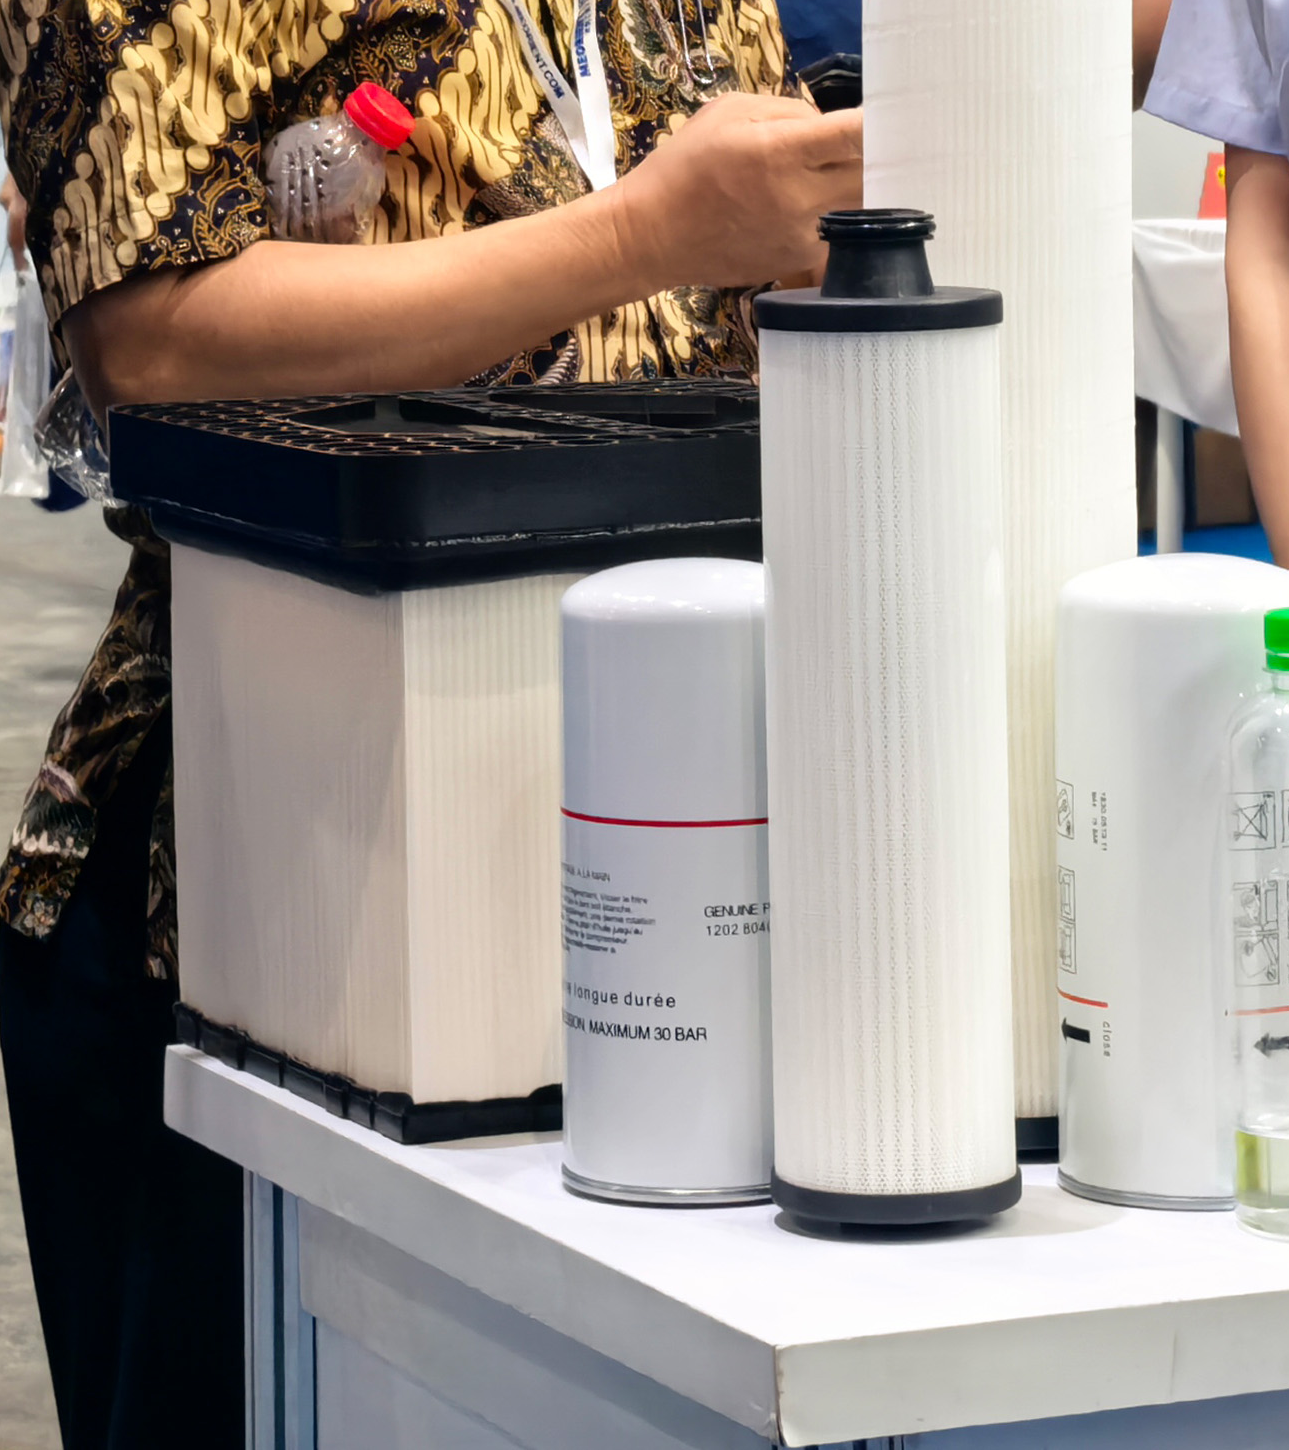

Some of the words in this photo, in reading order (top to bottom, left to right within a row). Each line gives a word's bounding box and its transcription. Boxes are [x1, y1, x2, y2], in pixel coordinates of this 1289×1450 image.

[704, 903, 759, 918] GENUINE
[706, 923, 739, 937] 1202
[573, 981, 619, 1006] longue
[623, 990, 677, 1009] durée
[589, 1018, 651, 1041] MAXIMUM
[654, 1026, 671, 1042] 30
[674, 1027, 708, 1042] BAR
[1101, 1019, 1111, 1058] close
